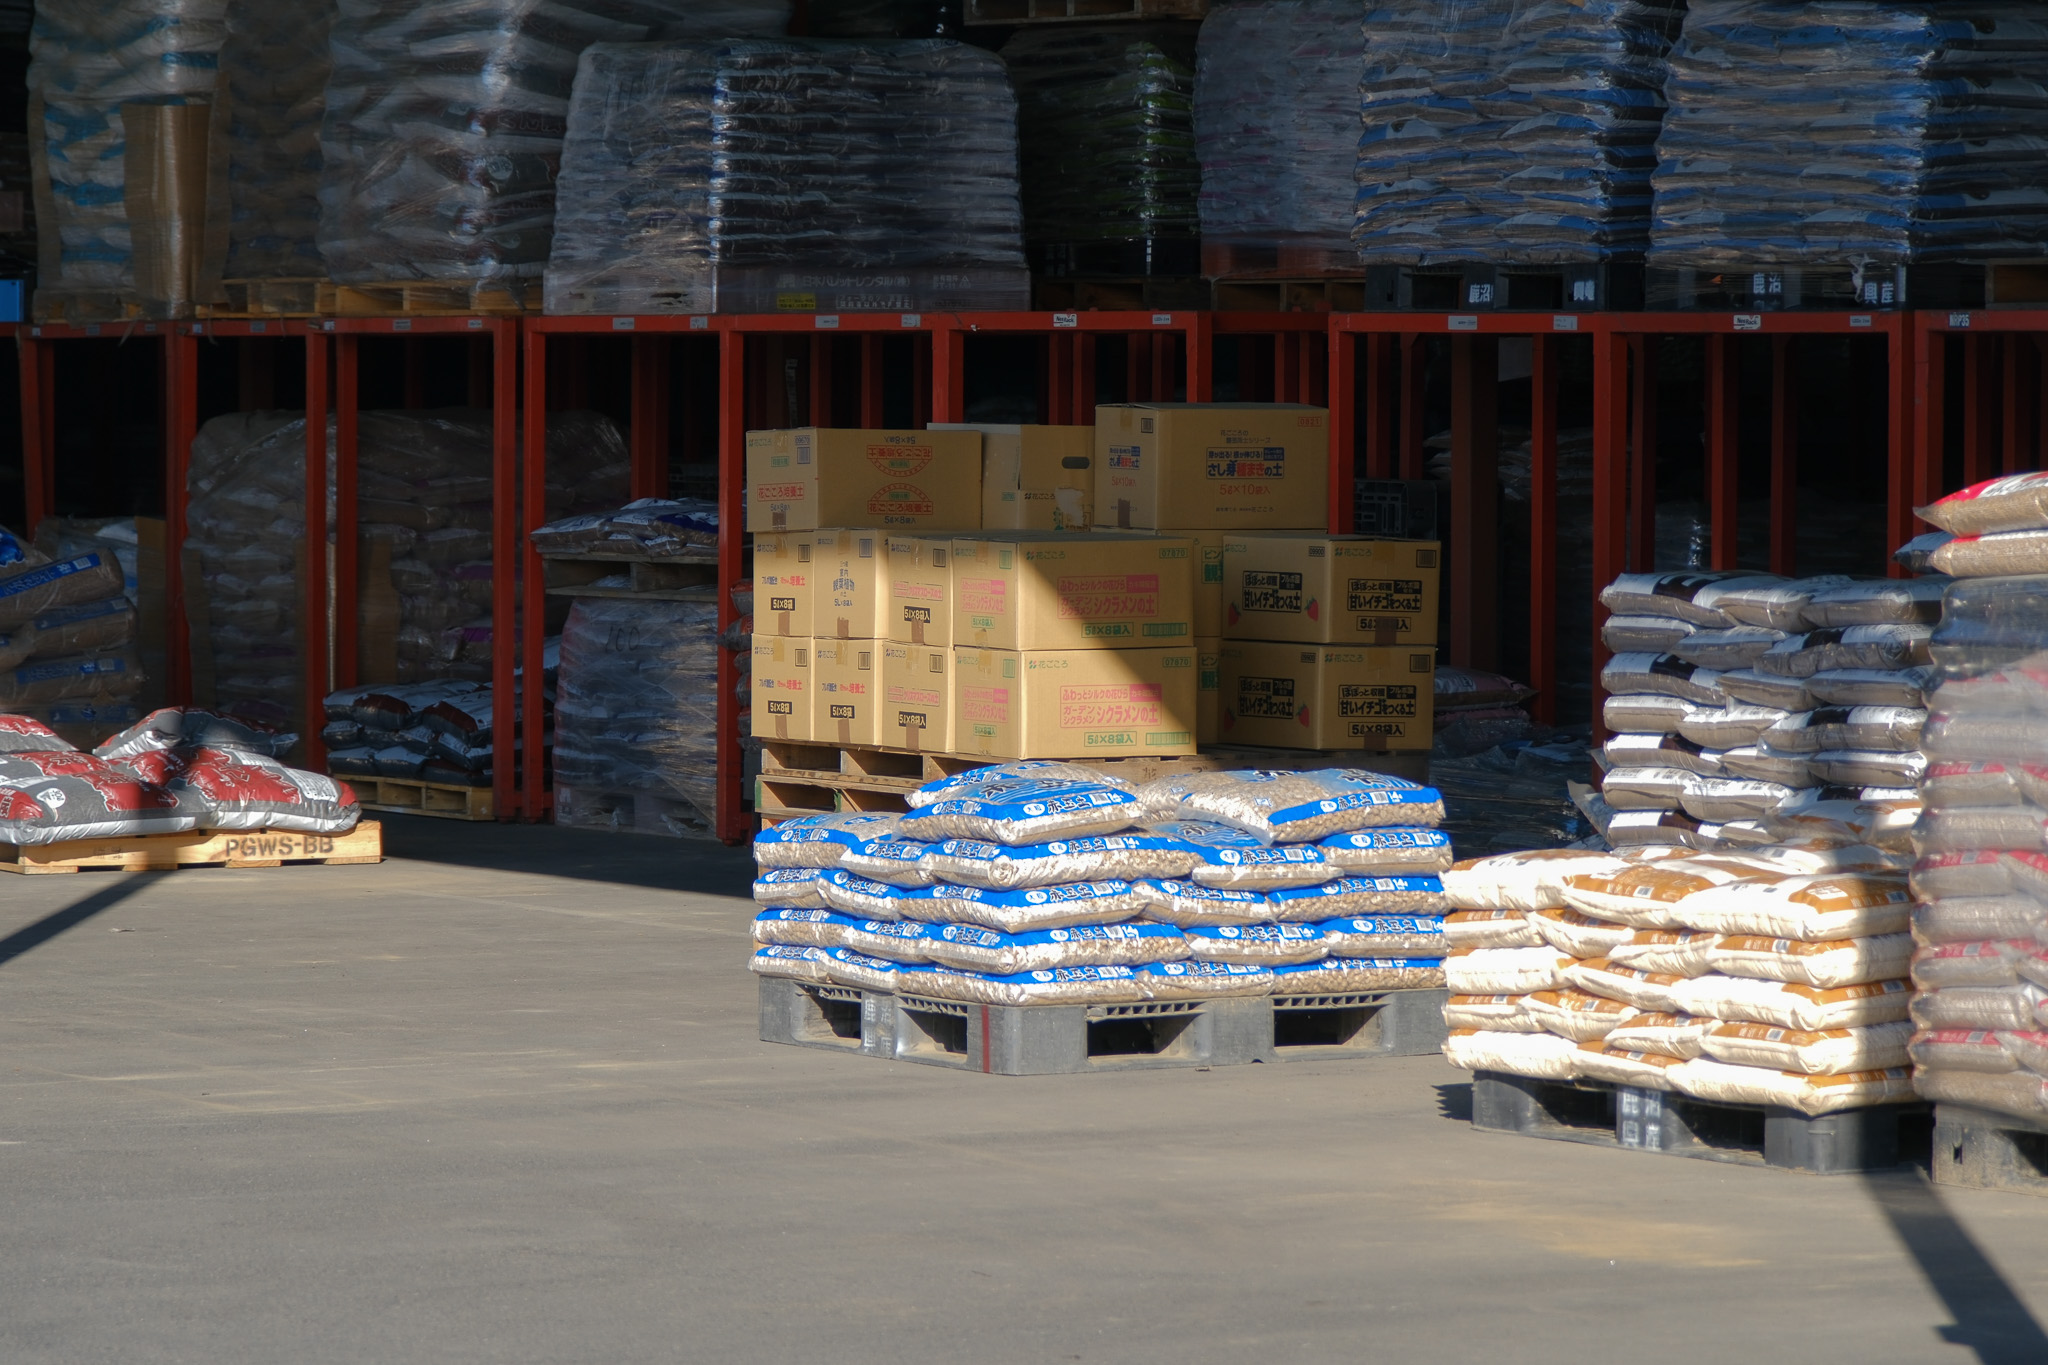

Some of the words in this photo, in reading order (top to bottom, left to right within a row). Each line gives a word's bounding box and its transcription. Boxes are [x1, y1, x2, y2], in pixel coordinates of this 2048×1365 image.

[869, 502, 933, 513] 花ごころ培養土
[1094, 595, 1155, 615] シクラメンの土
[1038, 659, 1069, 669] 花ごころ
[1062, 688, 1129, 702] ふわっとシルクの花びら
[1063, 705, 1095, 714] ガーデン
[1097, 705, 1159, 724] シクラメンの土
[1340, 698, 1415, 716] 甘いイチゴをつくる土
[1063, 715, 1095, 725] シクラメン
[1047, 796, 1093, 814] 赤玉土
[225, 835, 335, 857] PGWS-BB
[1068, 838, 1106, 852] 赤玉土
[1373, 832, 1416, 848] 赤玉土
[1242, 849, 1286, 863] 赤玉土
[1049, 884, 1093, 902] 赤玉土
[1180, 885, 1222, 900] 赤玉土
[1241, 925, 1281, 940] 赤玉土
[1375, 917, 1416, 933] 赤玉土
[1069, 927, 1107, 941] 赤玉土
[1056, 966, 1099, 981] 赤玉土
[1186, 962, 1228, 976] 赤玉土
